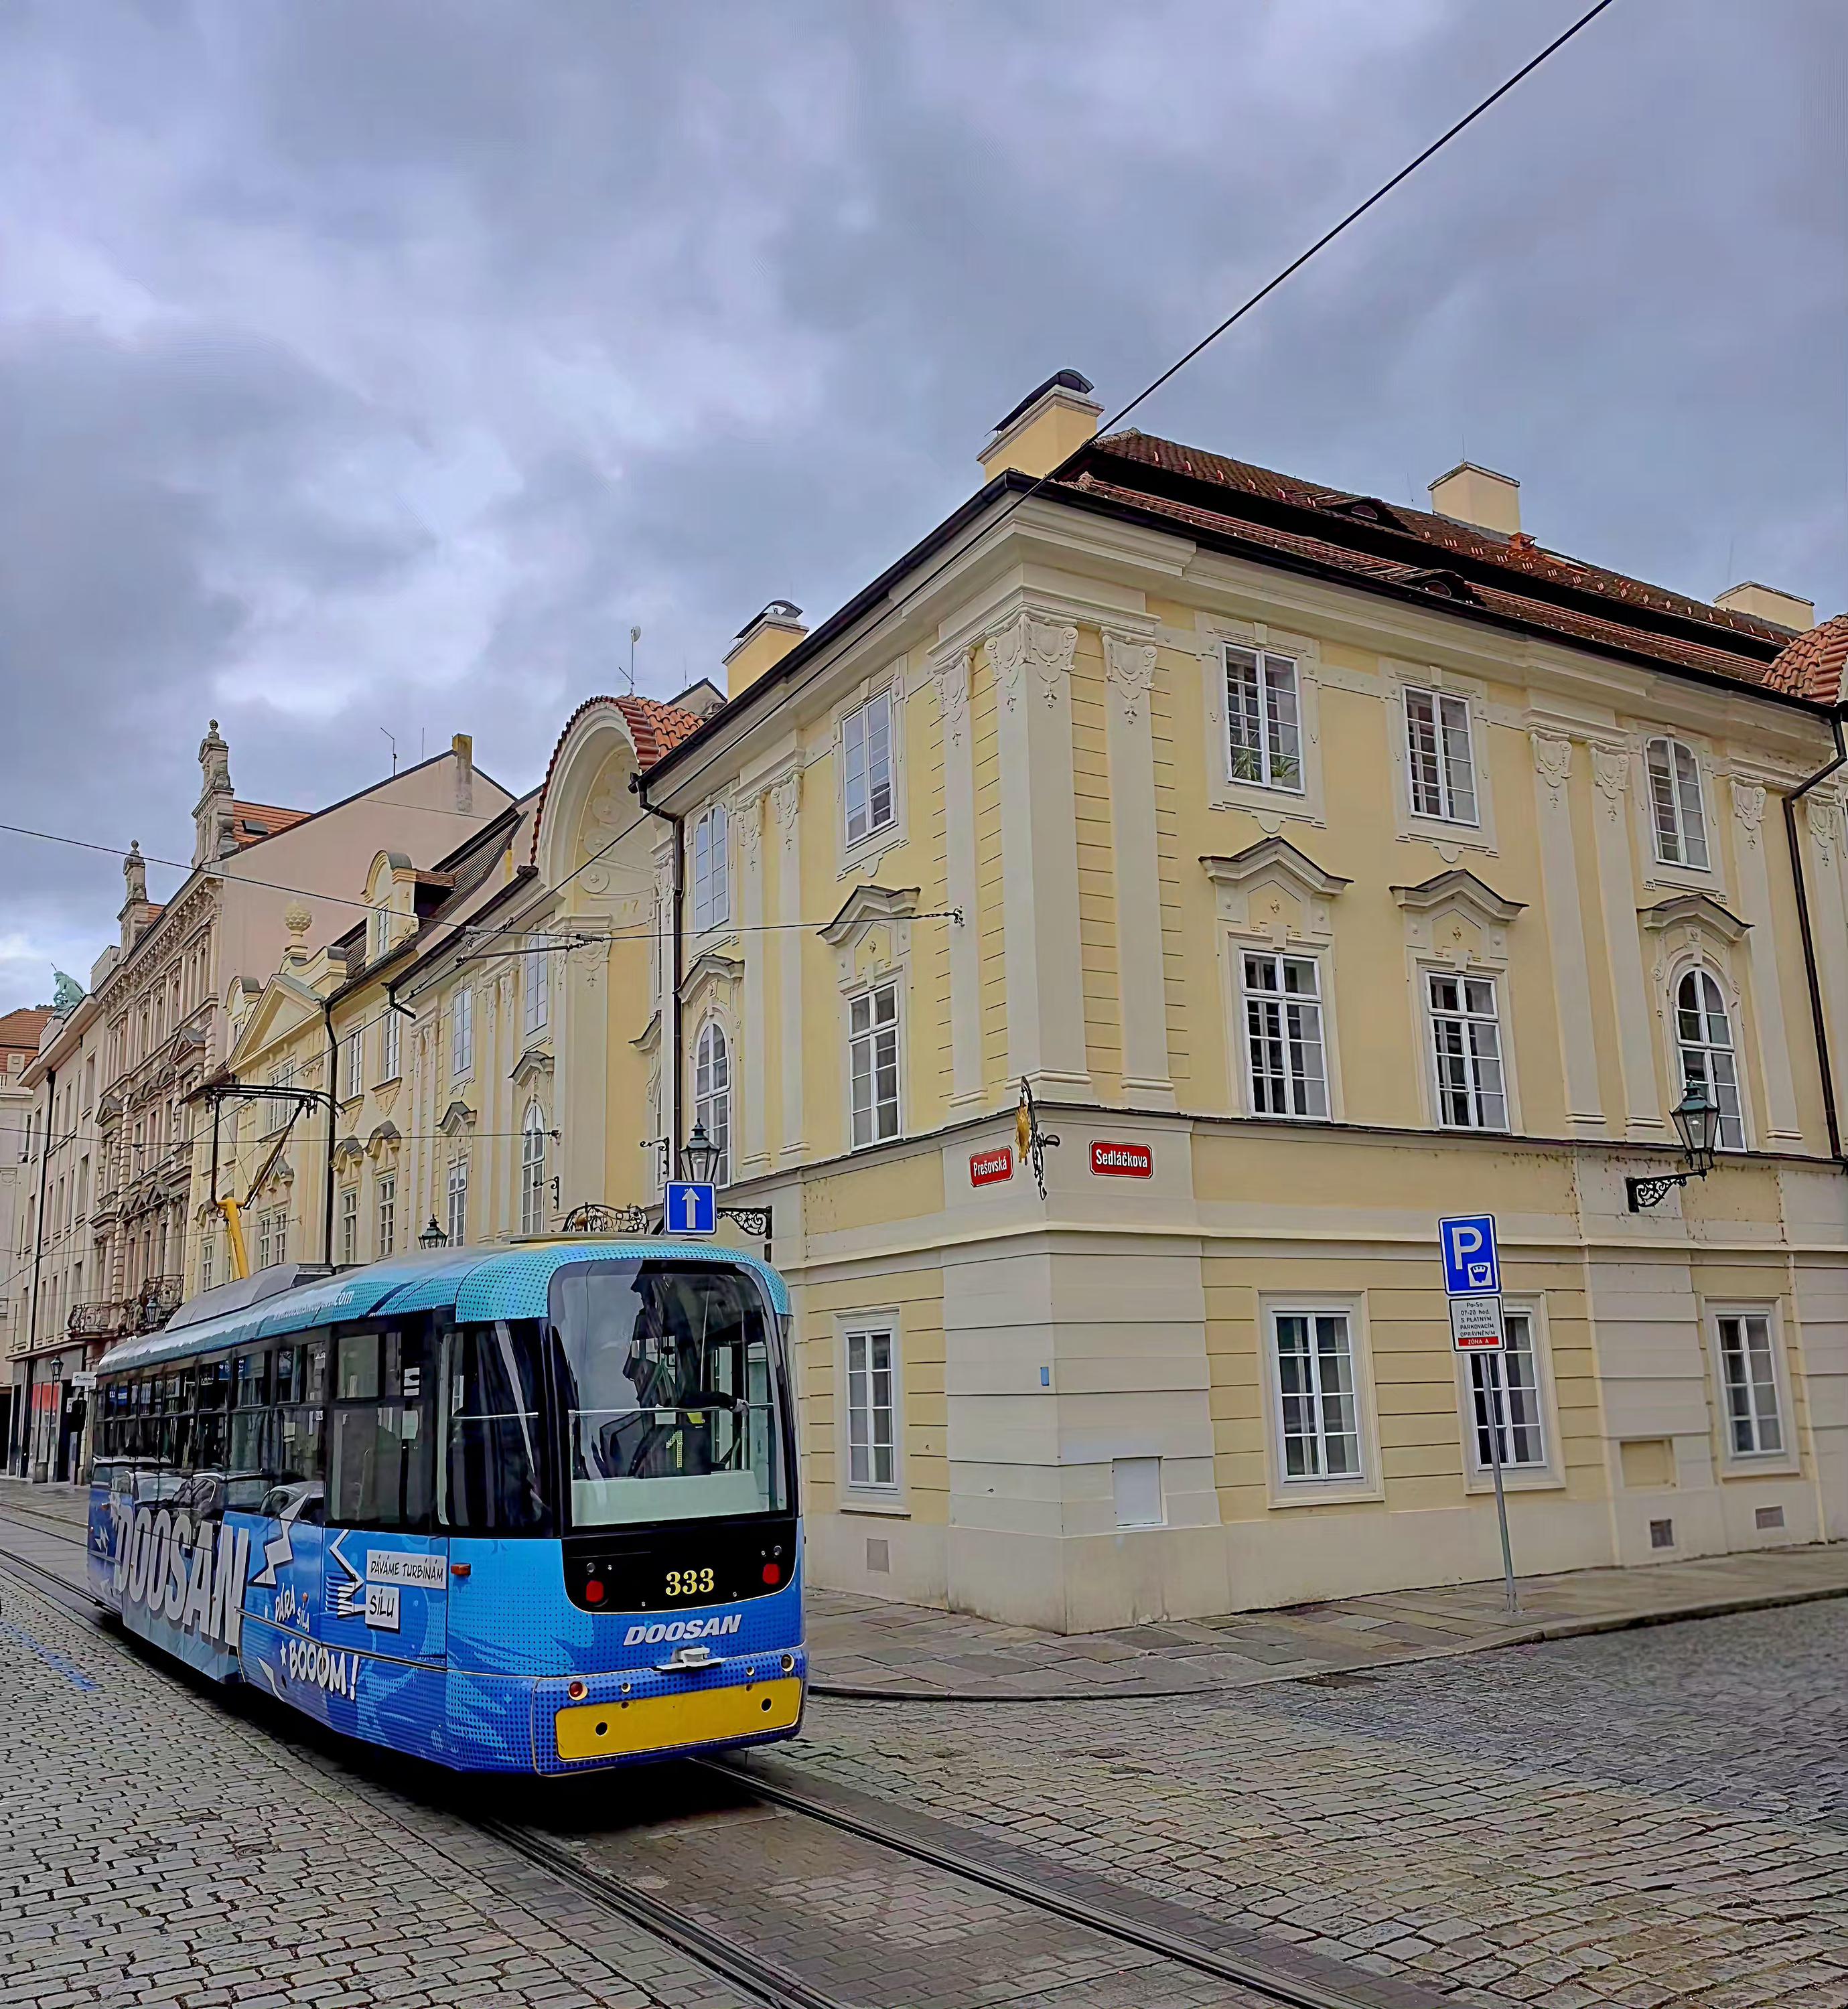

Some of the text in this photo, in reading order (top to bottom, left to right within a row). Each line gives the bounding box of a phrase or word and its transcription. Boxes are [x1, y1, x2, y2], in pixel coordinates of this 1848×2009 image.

[973, 1155, 1007, 1177] Prešovská
[1095, 1148, 1148, 1169] Sedláčkova
[1451, 1226, 1483, 1270] P
[113, 1505, 249, 1647] DOOSAN
[370, 1554, 443, 1582] DÁVÁME TURBÍNÁM
[665, 1568, 715, 1596] 333
[275, 1582, 295, 1623] PÁRA
[369, 1588, 395, 1618] SÍLU
[623, 1614, 742, 1646] DOOSAN
[289, 1639, 359, 1700] BOOOM!
